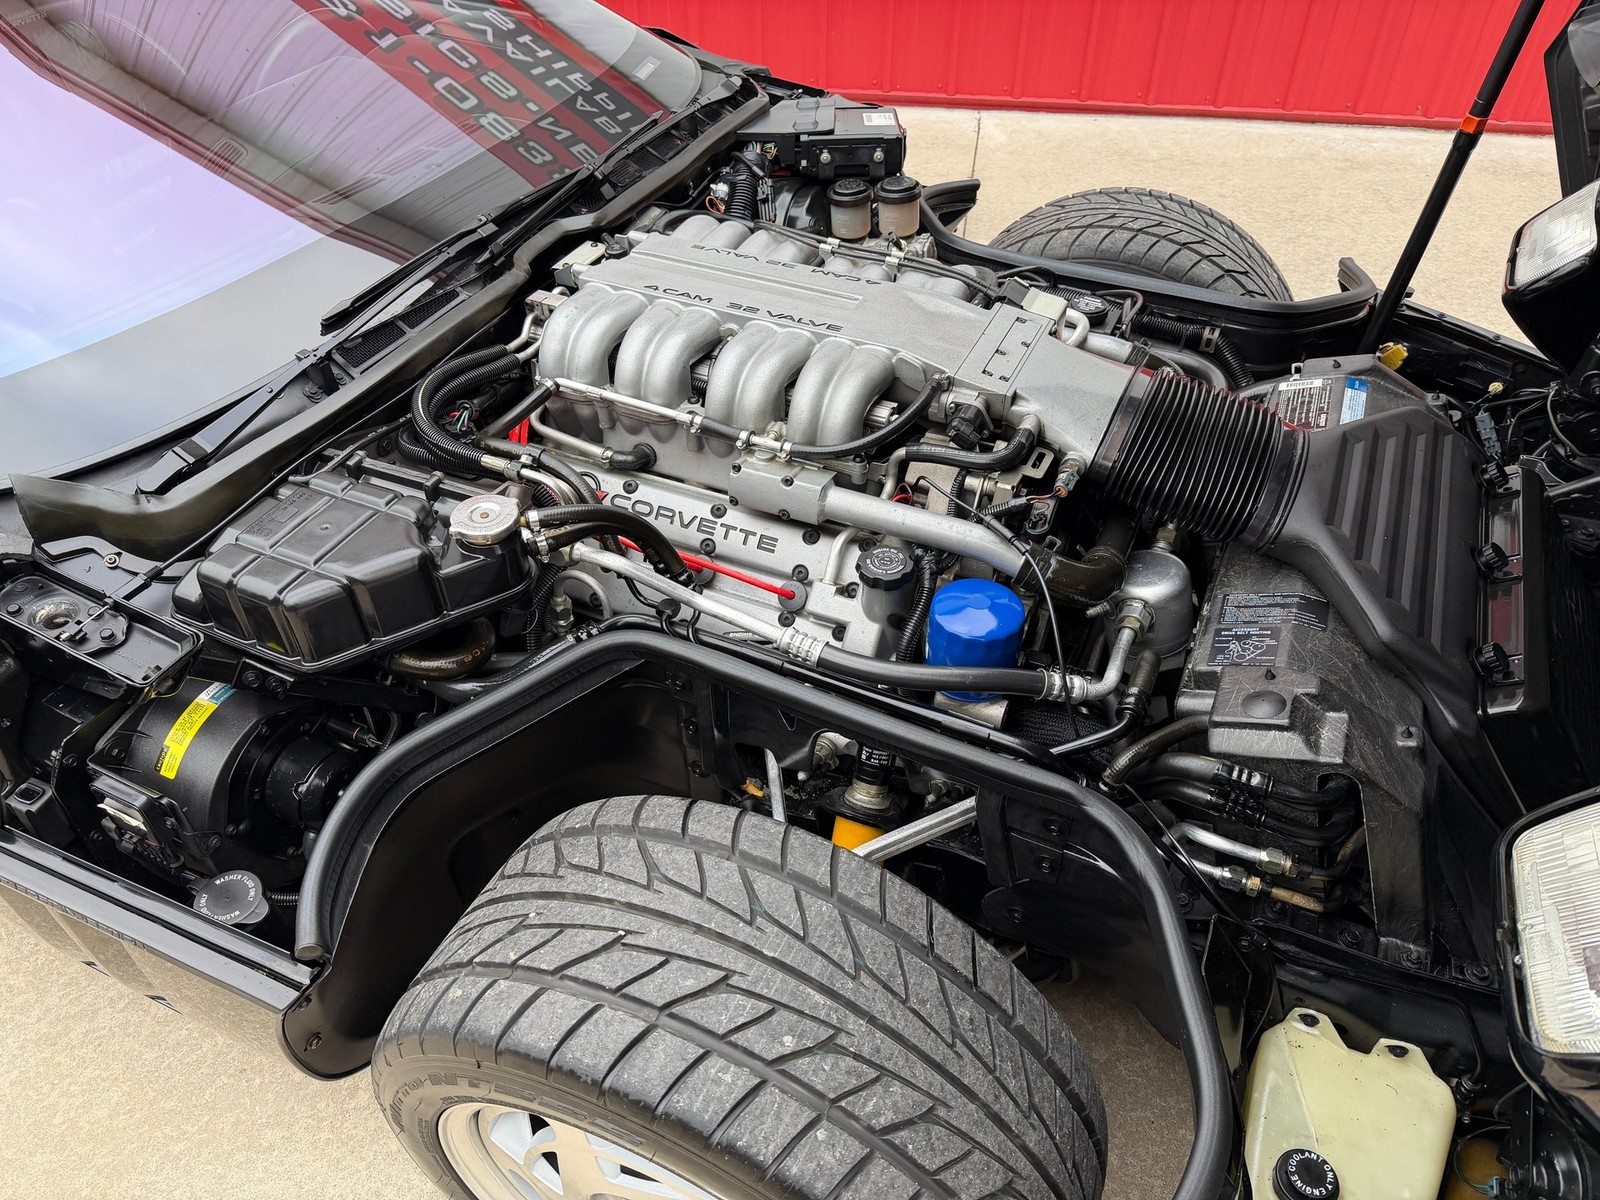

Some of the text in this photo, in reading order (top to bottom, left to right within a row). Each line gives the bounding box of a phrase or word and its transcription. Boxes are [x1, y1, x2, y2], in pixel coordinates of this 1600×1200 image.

[690, 243, 760, 262] VALVE
[766, 259, 798, 270] 32
[811, 268, 862, 283] CAM
[662, 287, 714, 304] CAM
[726, 301, 761, 315] 32
[766, 309, 844, 333] VALVE
[610, 493, 779, 555] CORVETTE
[214, 874, 242, 885] WASHER
[1288, 1151, 1335, 1196] ENGINE COOLANT ONLY
